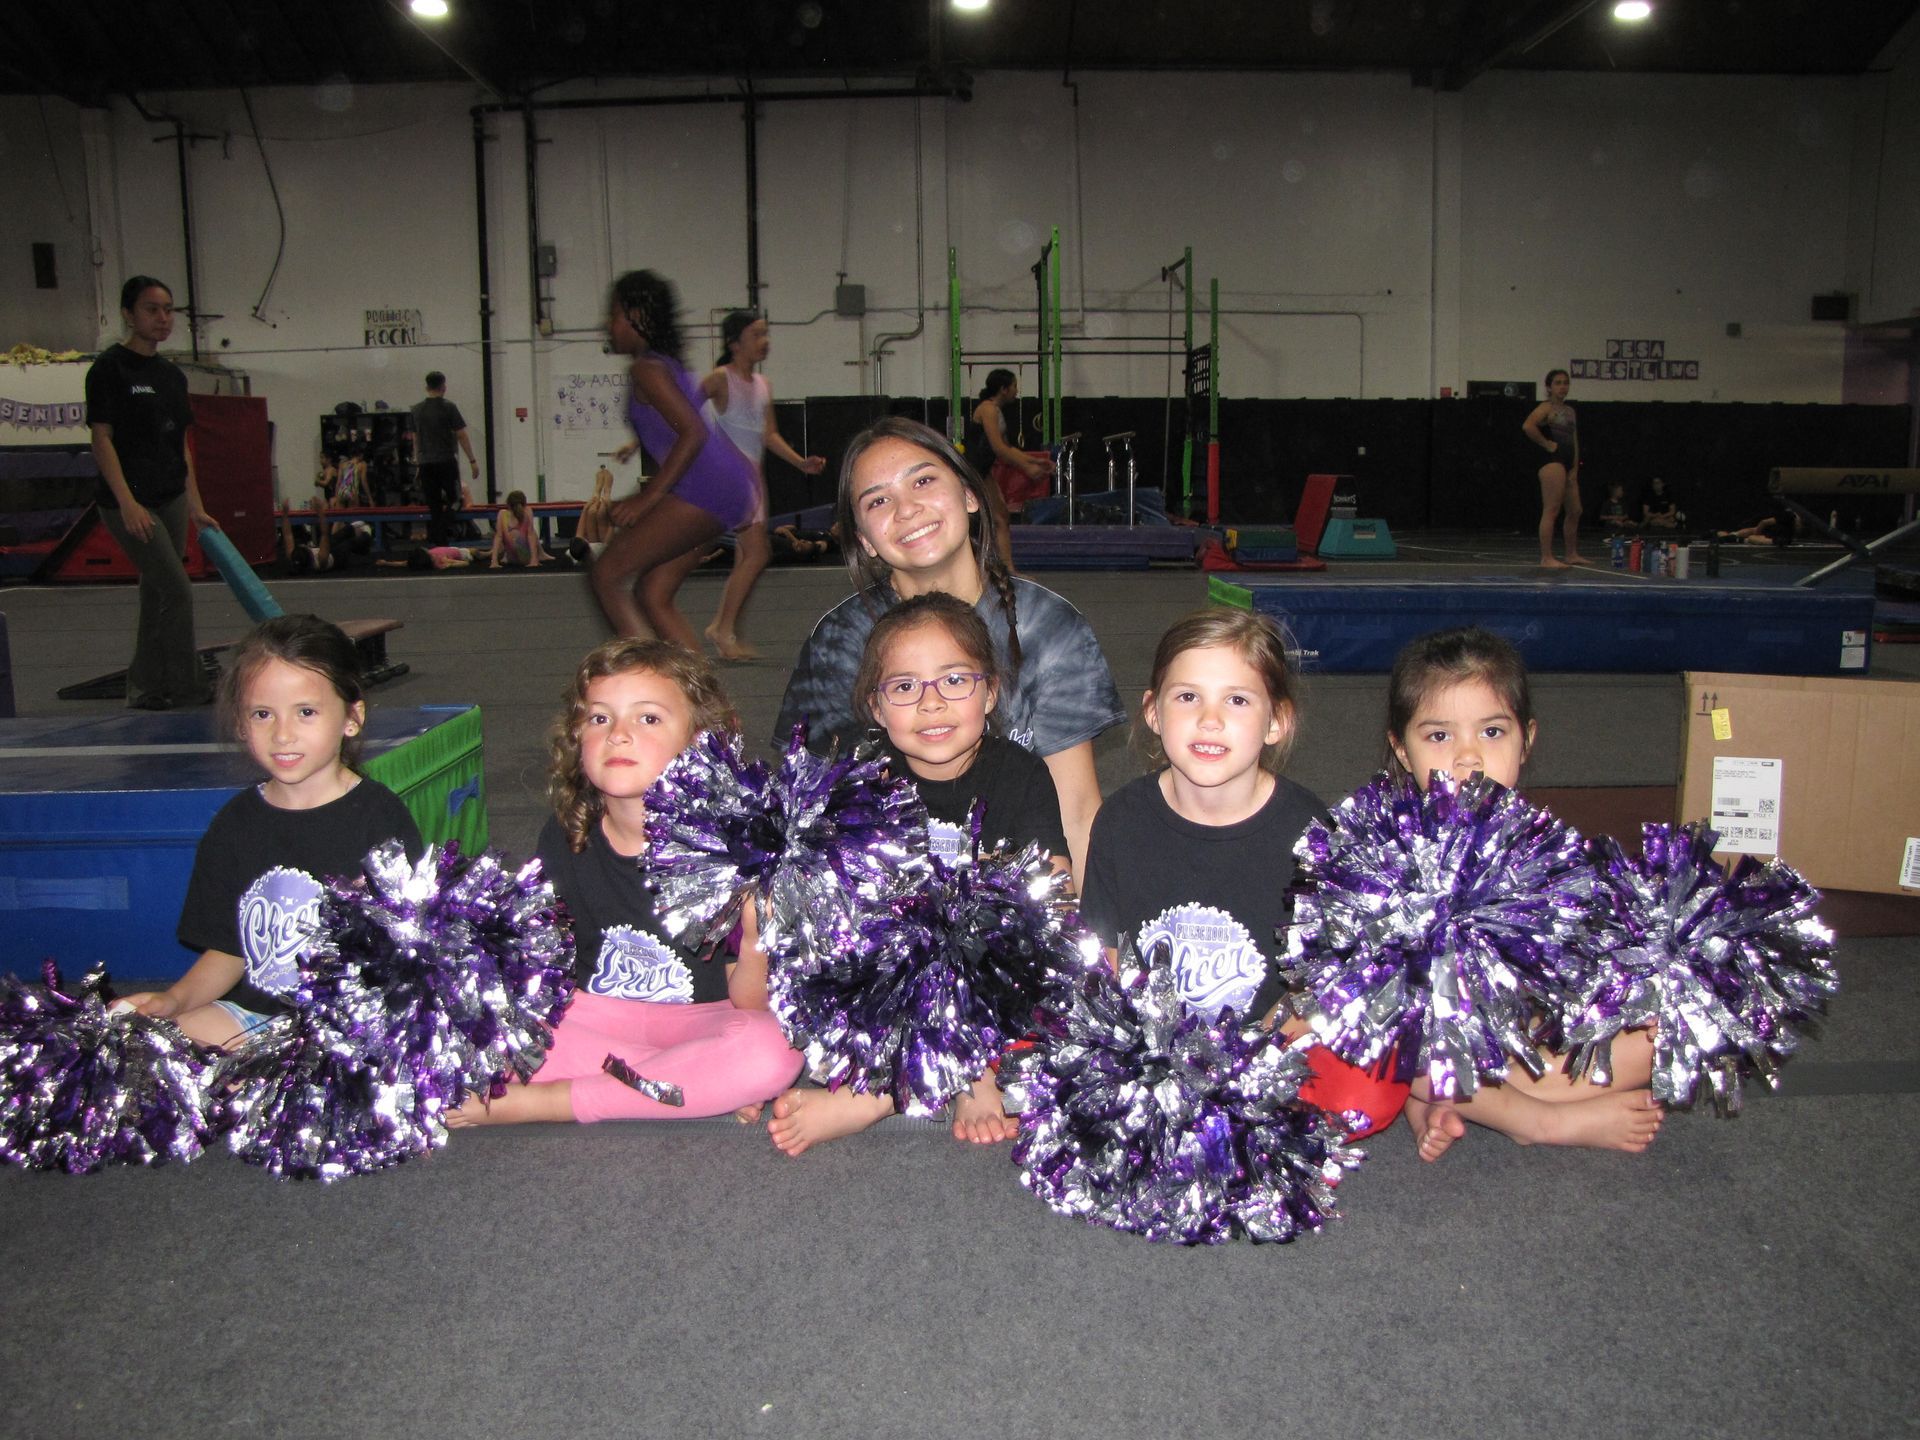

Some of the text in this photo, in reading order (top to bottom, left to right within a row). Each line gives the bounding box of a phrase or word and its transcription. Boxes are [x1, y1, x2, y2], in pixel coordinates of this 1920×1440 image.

[364, 327, 417, 346] ROCK!
[1606, 339, 1665, 359] PESA
[1571, 360, 1699, 380] WRESTLING
[0, 402, 82, 424] SENIO
[1303, 649, 1320, 657] Trak
[1175, 922, 1231, 944] PRESCHOOL
